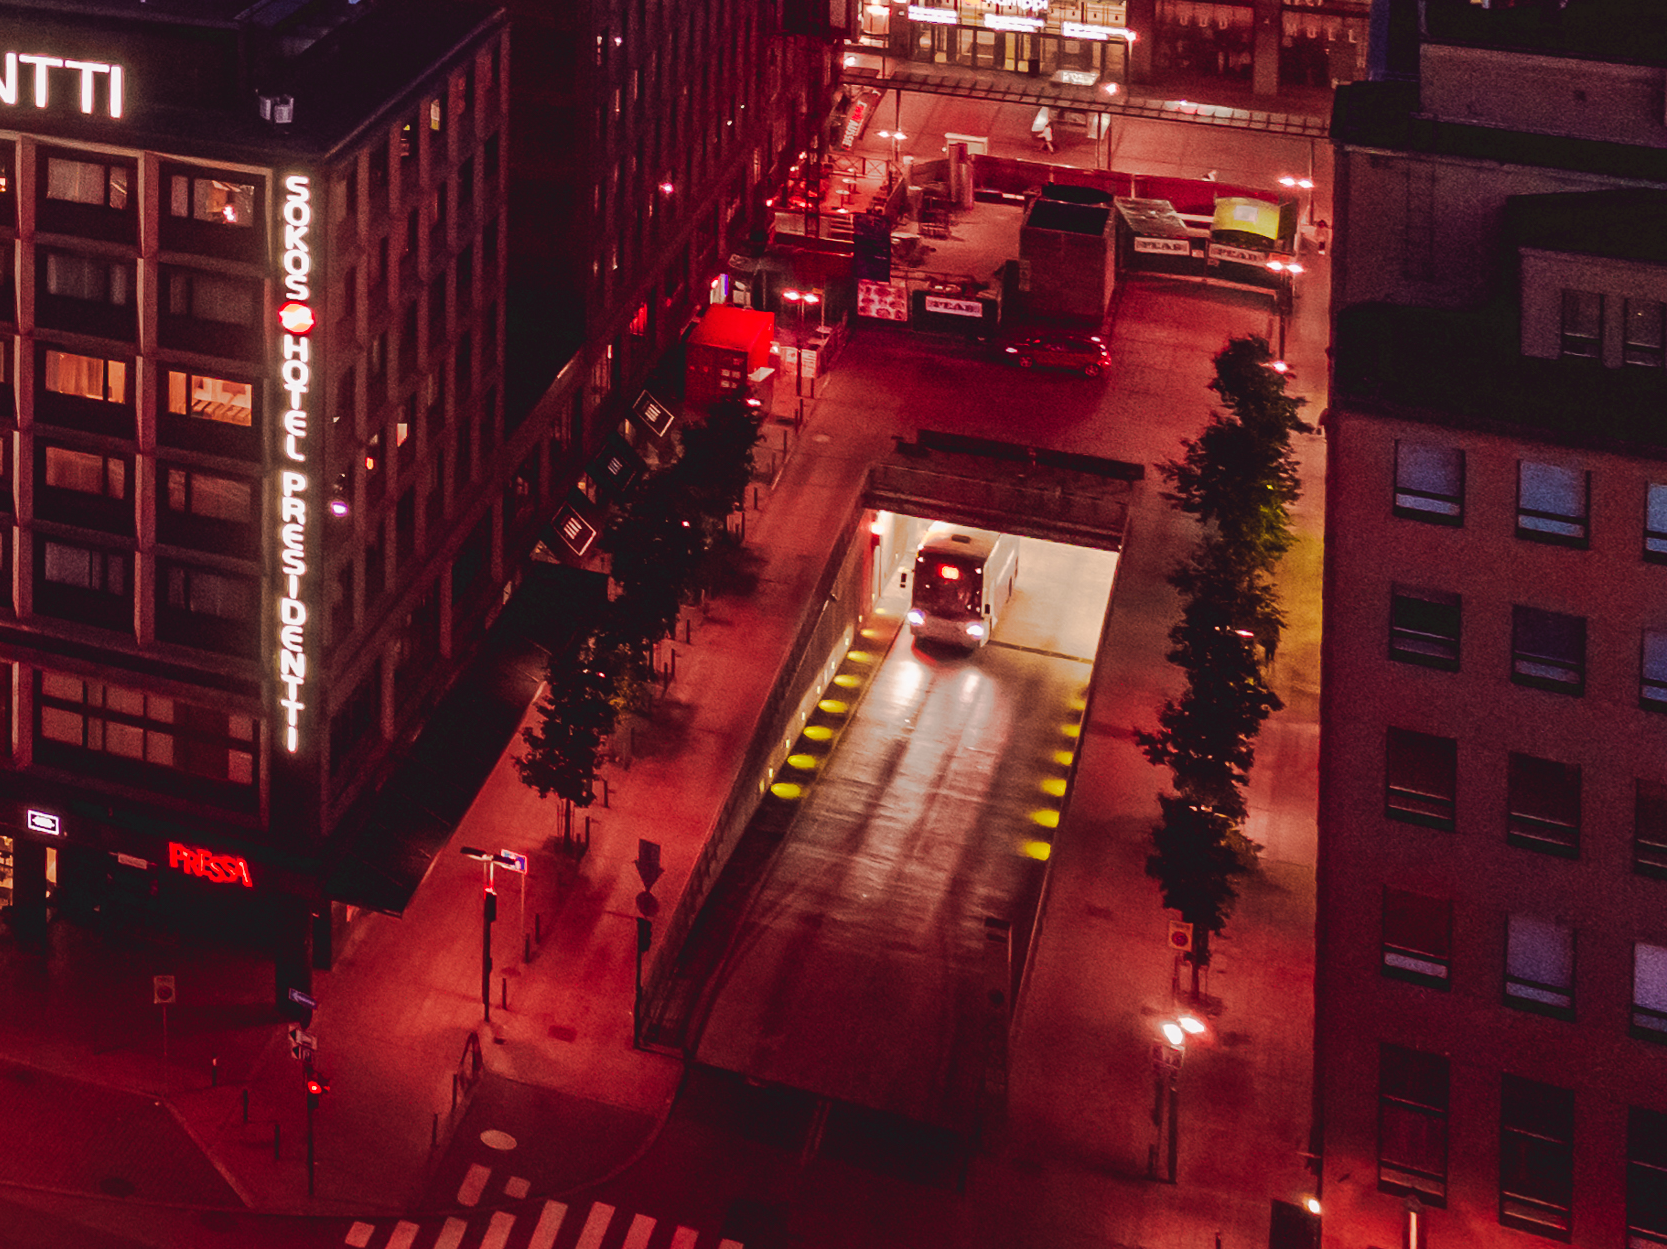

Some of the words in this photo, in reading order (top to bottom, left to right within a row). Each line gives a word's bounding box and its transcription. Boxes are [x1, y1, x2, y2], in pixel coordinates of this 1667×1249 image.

[283, 175, 311, 301] SOKOS
[282, 334, 309, 462] HOTEL
[280, 471, 308, 753] PRESIDENTTI
